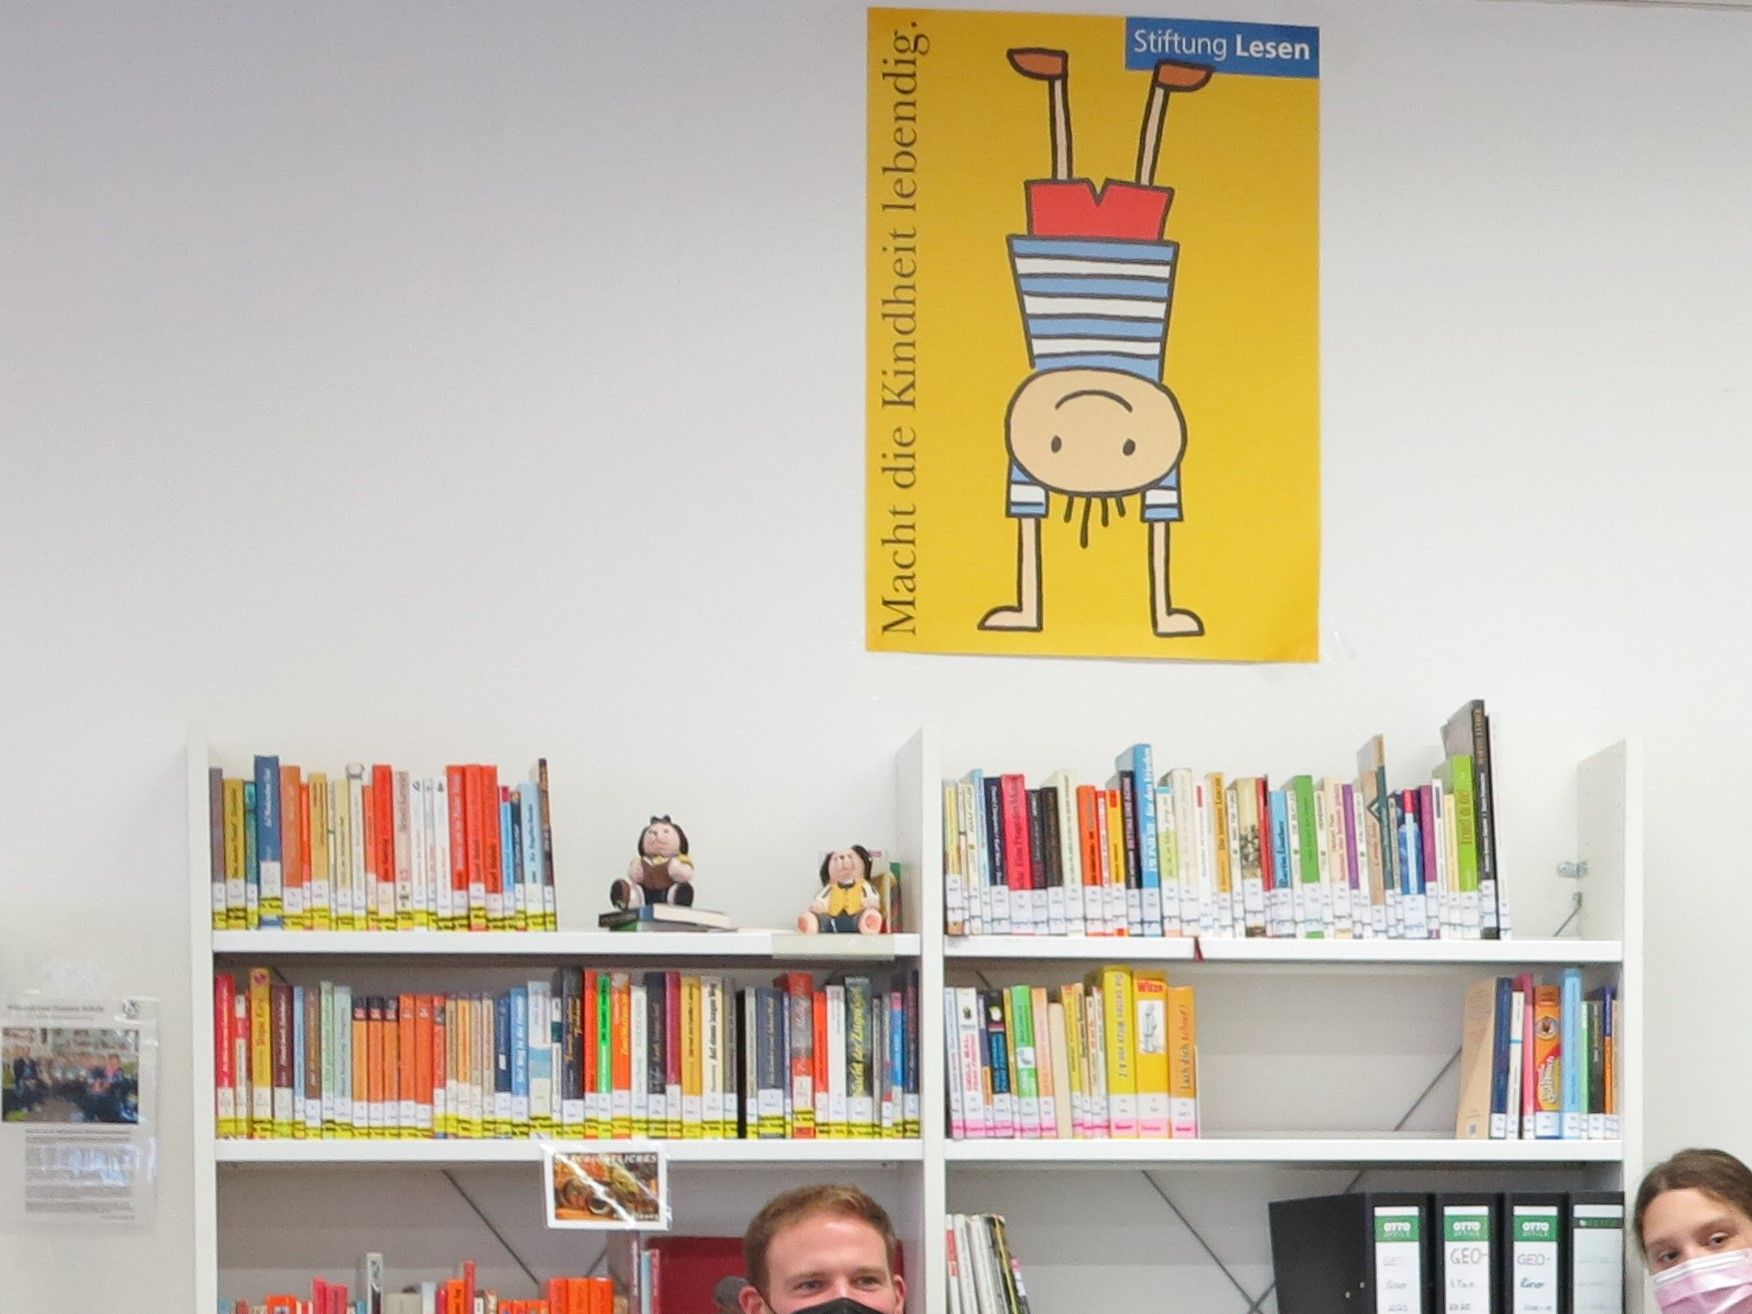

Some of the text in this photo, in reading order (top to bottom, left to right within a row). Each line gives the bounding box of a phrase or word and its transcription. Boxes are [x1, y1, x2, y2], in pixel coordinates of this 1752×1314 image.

[1134, 30, 1311, 61] Stiftung Lesen
[881, 20, 930, 636] Macht die Kindheit lebendig.
[1383, 1221, 1411, 1232] OTTO
[1452, 1221, 1481, 1232] OTTO
[1521, 1221, 1550, 1232] OTTO
